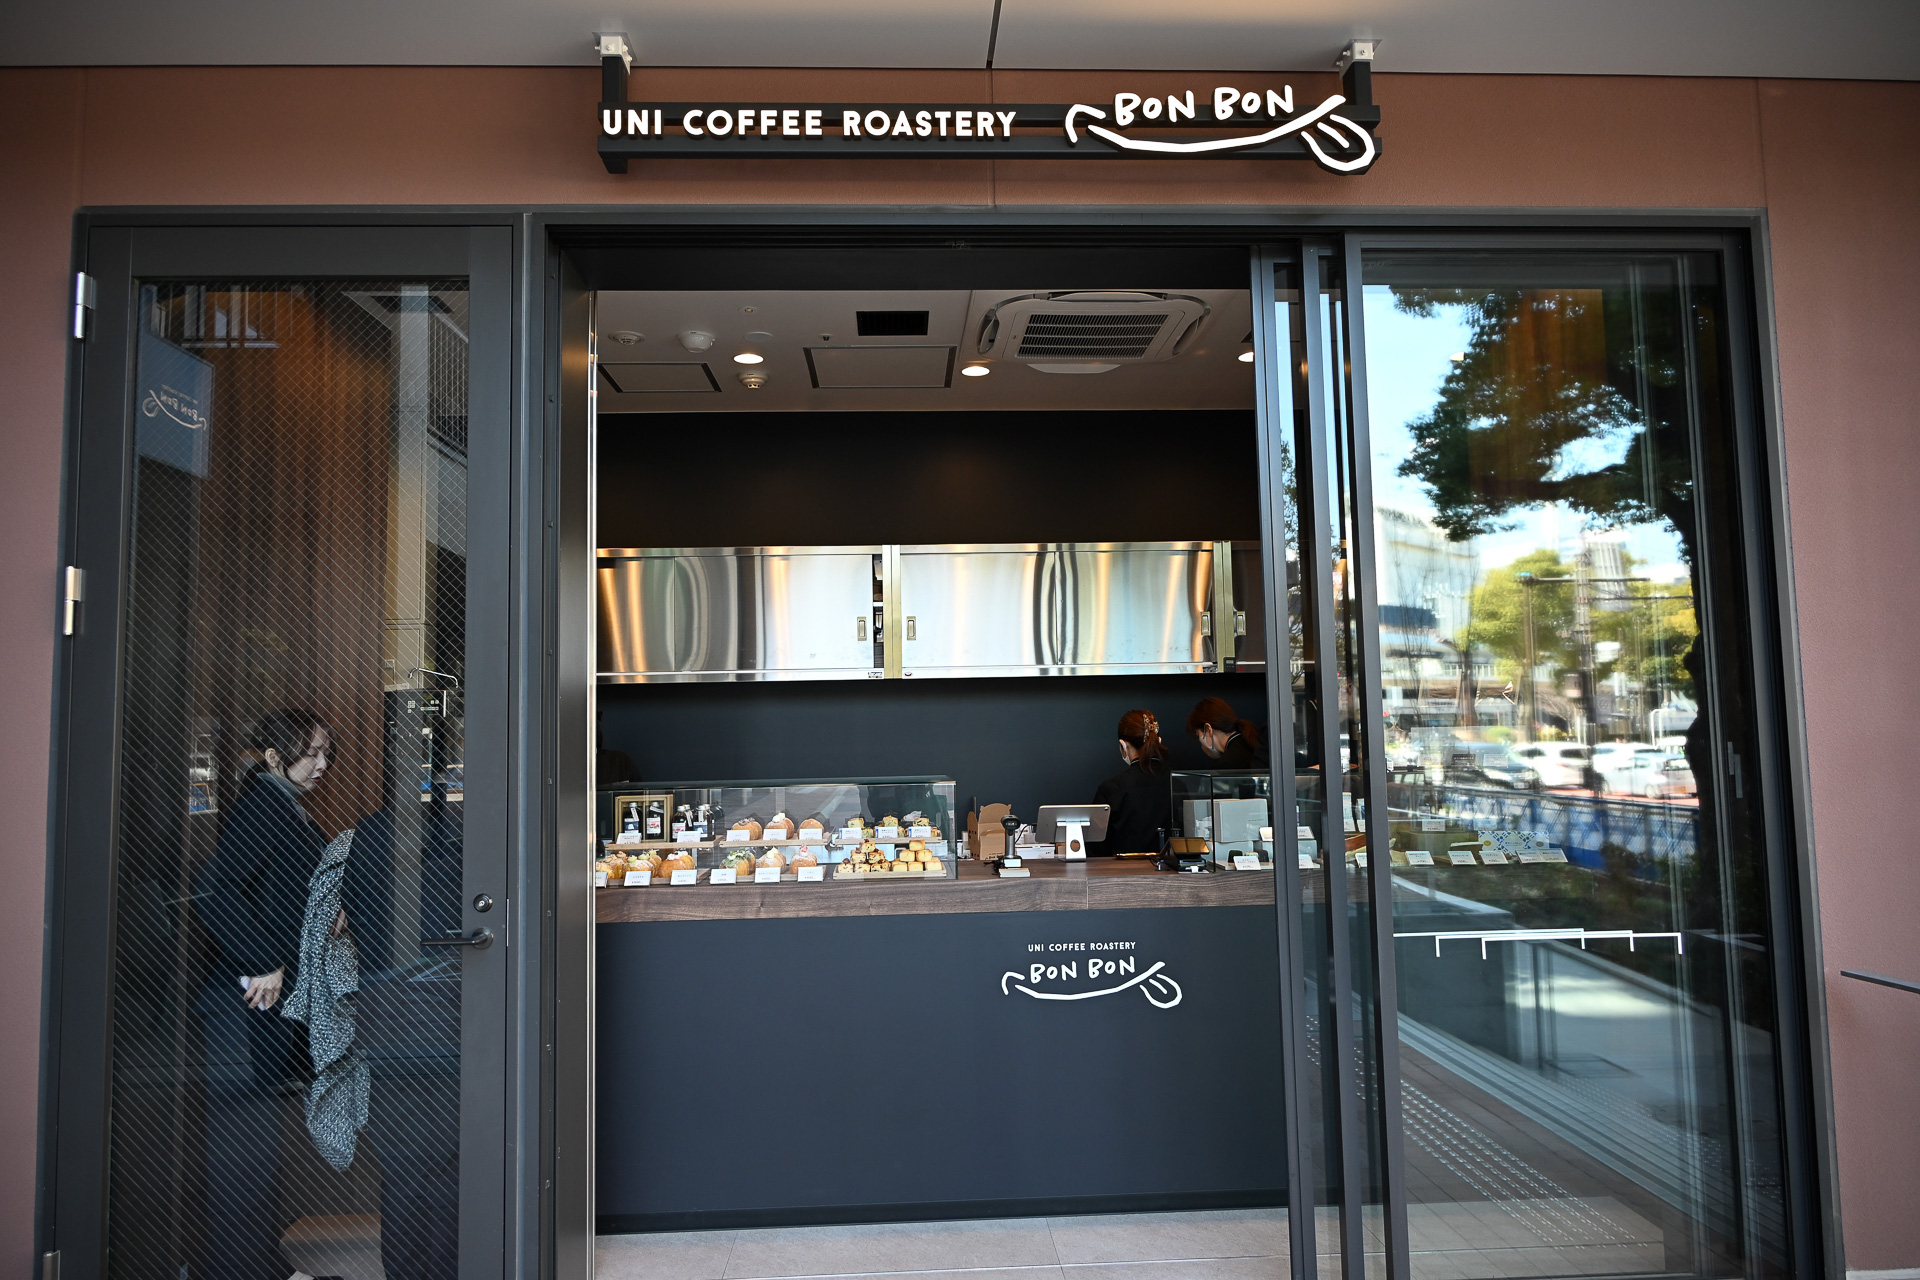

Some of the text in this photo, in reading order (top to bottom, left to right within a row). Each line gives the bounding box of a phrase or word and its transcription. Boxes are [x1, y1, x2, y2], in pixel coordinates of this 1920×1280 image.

[603, 109, 1017, 137] UNI COFFEE ROASTERY
[1028, 942, 1136, 952] UNI COFFEE ROASTERY
